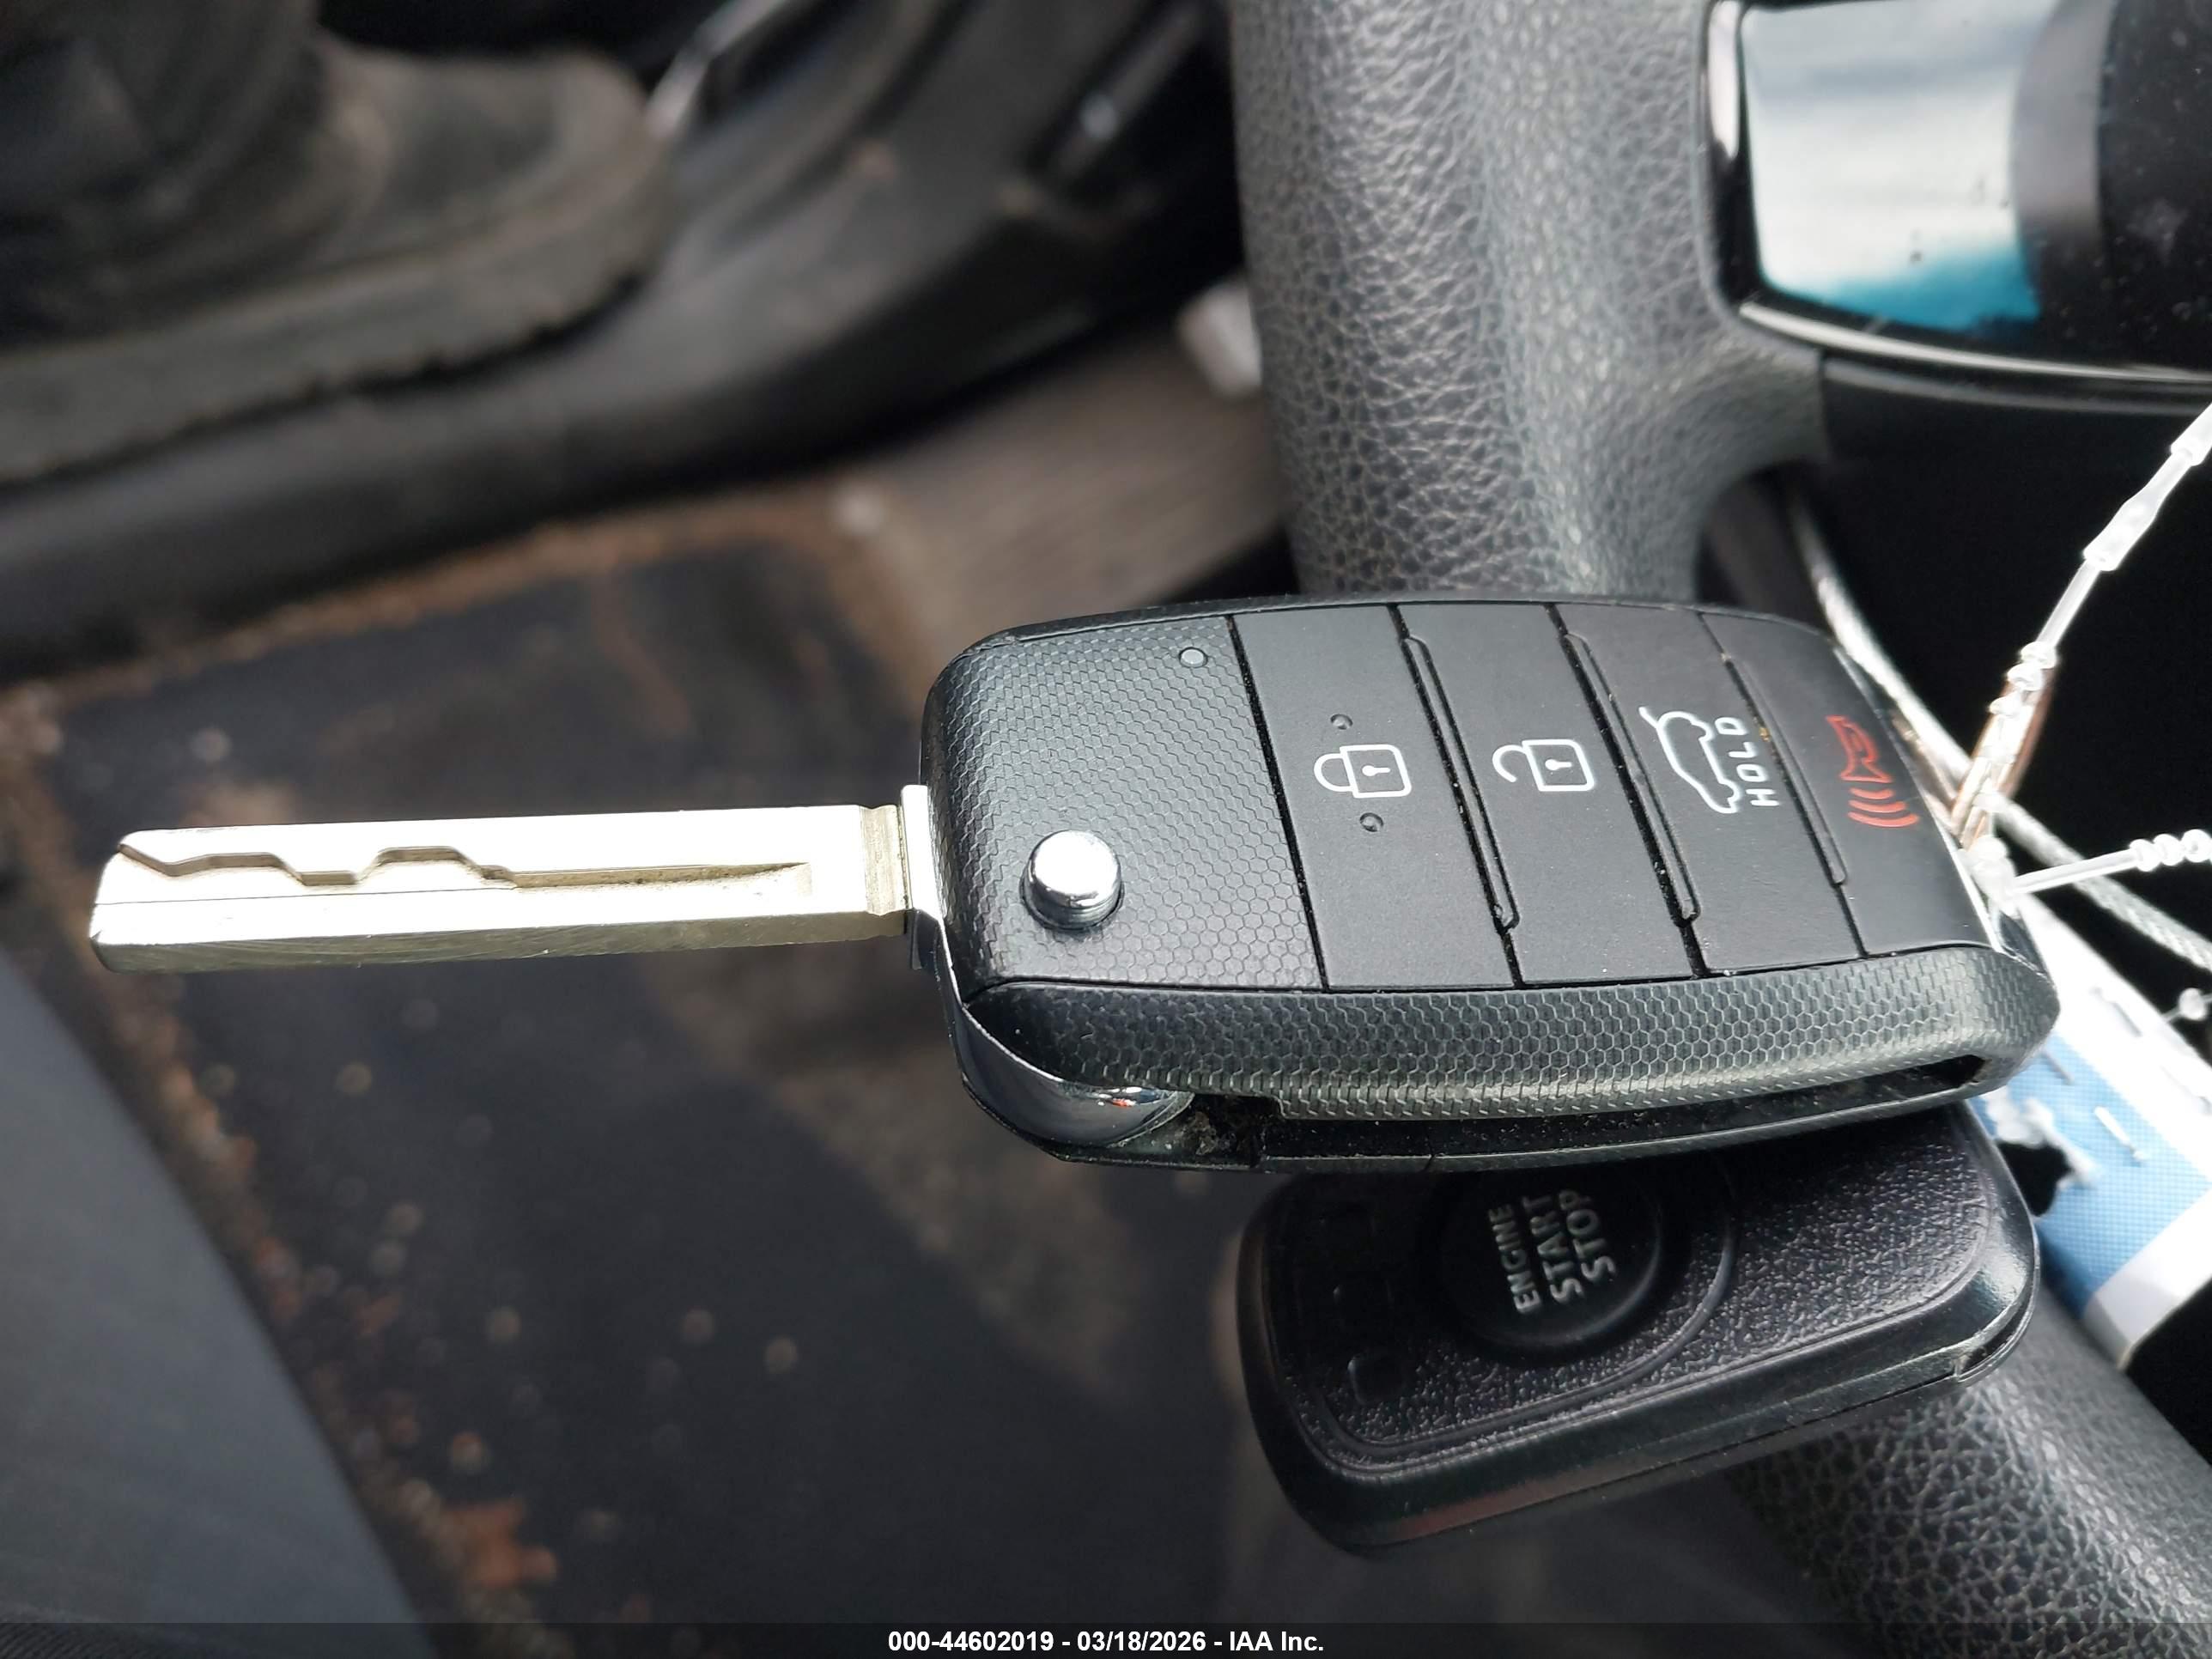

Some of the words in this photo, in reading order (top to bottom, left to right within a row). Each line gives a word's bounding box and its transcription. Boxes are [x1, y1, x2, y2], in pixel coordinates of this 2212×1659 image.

[1714, 716, 1781, 807] HOLD
[1487, 1205, 1543, 1314] ENGINE
[1522, 1195, 1584, 1304] START
[1559, 1189, 1617, 1282] STOP
